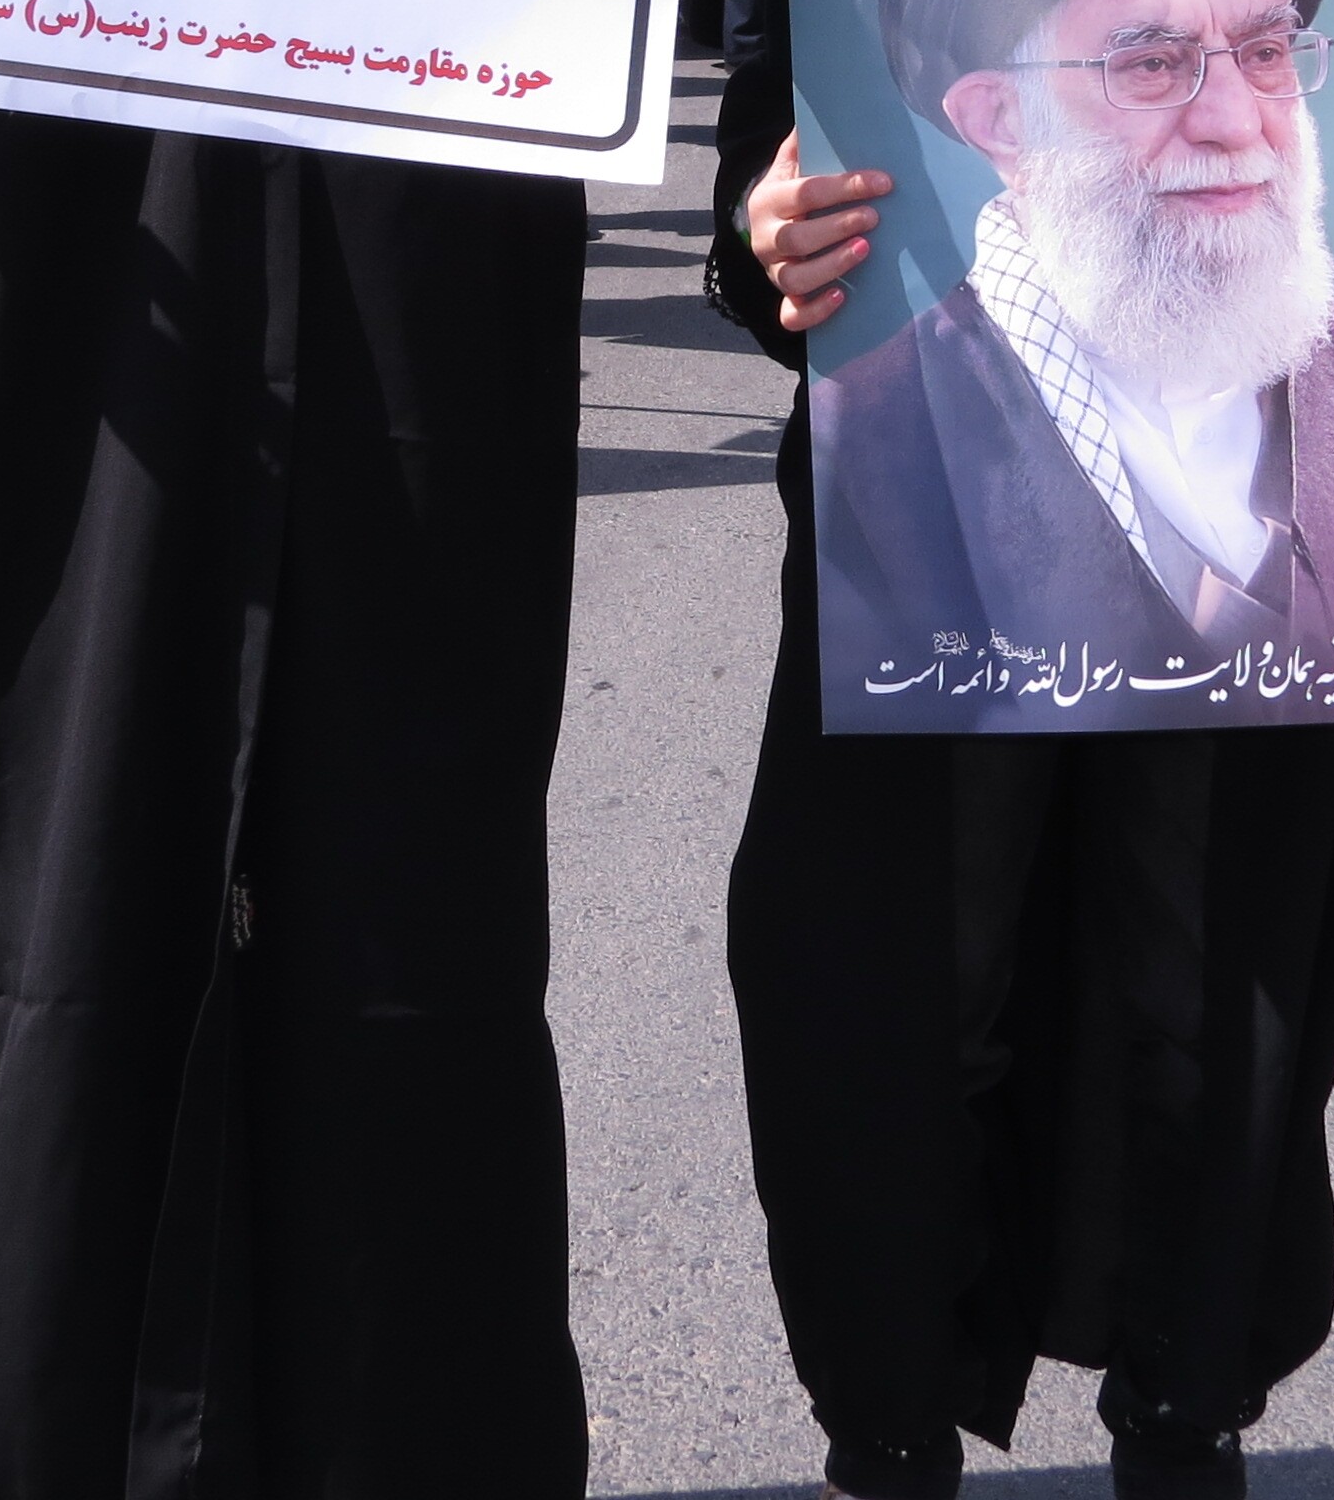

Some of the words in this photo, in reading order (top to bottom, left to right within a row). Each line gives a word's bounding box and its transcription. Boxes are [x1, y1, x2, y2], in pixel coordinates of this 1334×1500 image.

[177, 21, 277, 58] حضرت
[284, 37, 355, 75] بسیج
[363, 47, 469, 86] مقاومت
[476, 62, 553, 99] حوزه
[864, 660, 945, 694] است
[1053, 640, 1124, 708] رسول
[1258, 644, 1316, 701] همان
